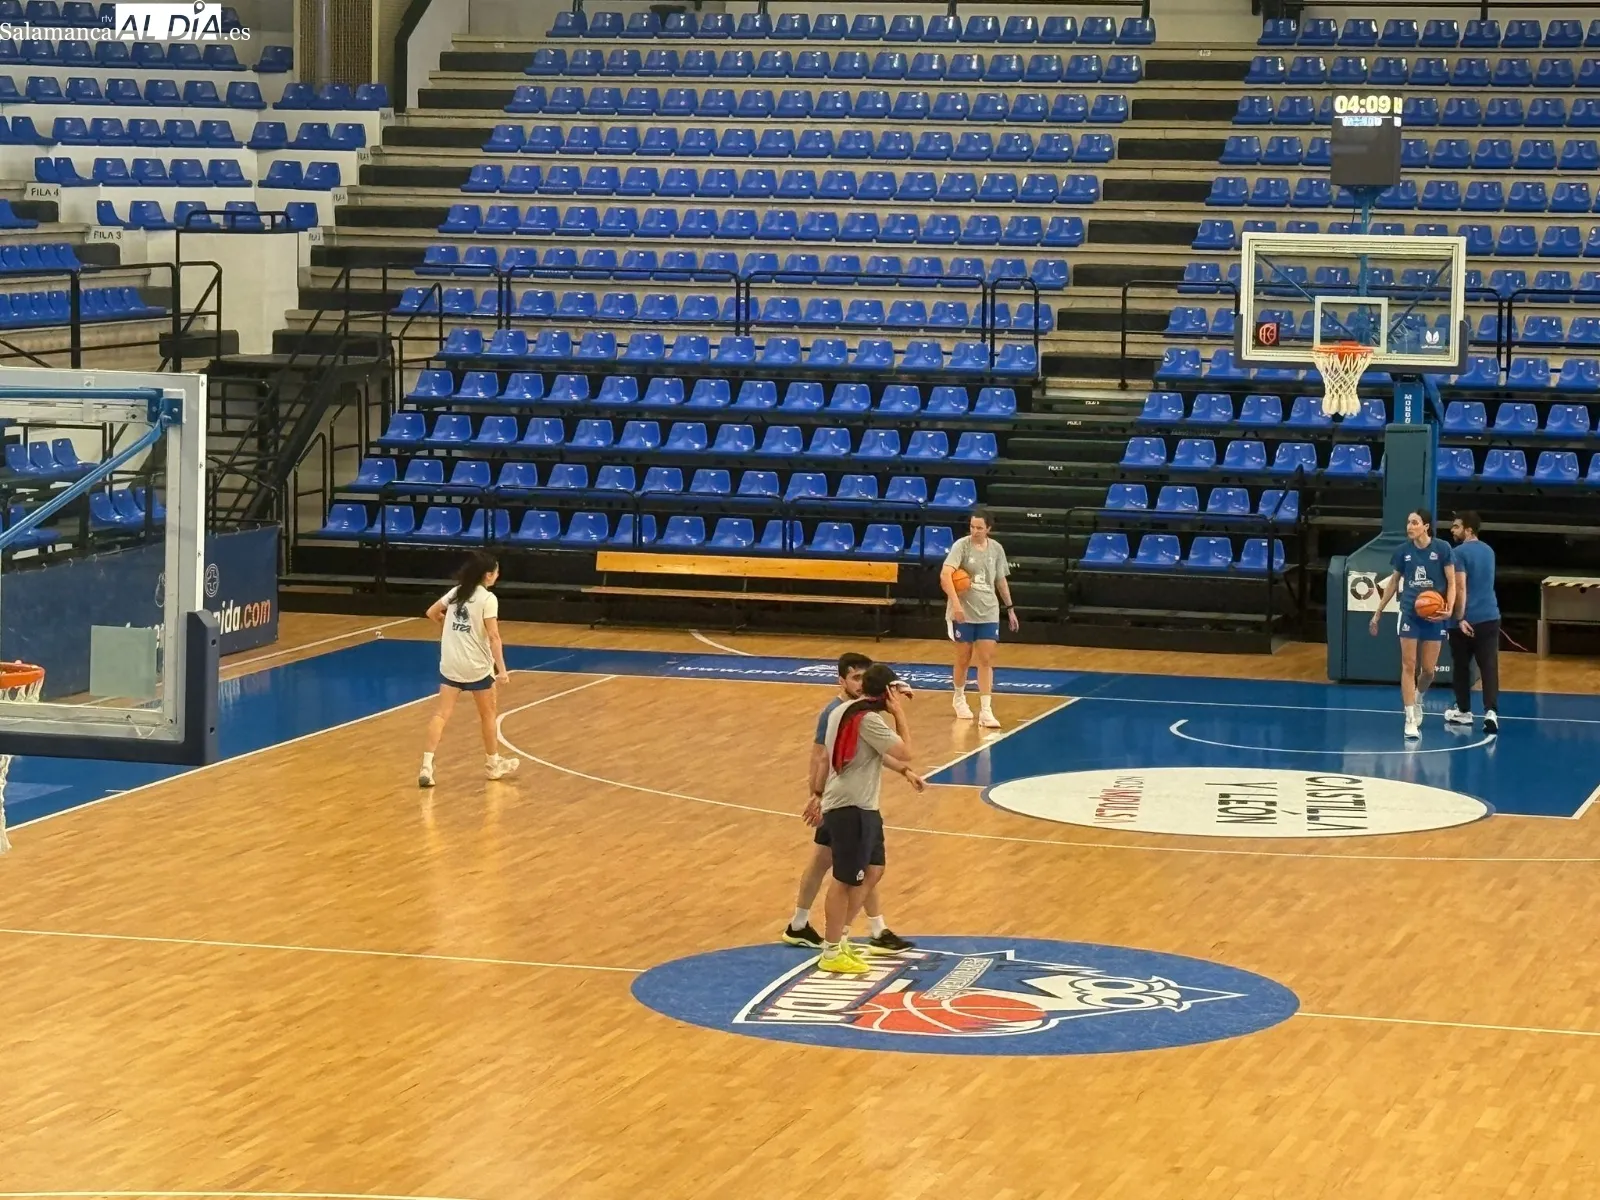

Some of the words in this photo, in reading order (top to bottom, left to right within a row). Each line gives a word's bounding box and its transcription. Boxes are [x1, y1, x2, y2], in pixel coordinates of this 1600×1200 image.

[1334, 95, 1391, 114] 04:09
[31, 187, 52, 197] FILA
[53, 188, 59, 197] 4
[93, 230, 114, 240] FILA
[115, 231, 122, 240] 3
[1216, 792, 1302, 825] LEÓN
[1305, 776, 1368, 831] CASTILLA
